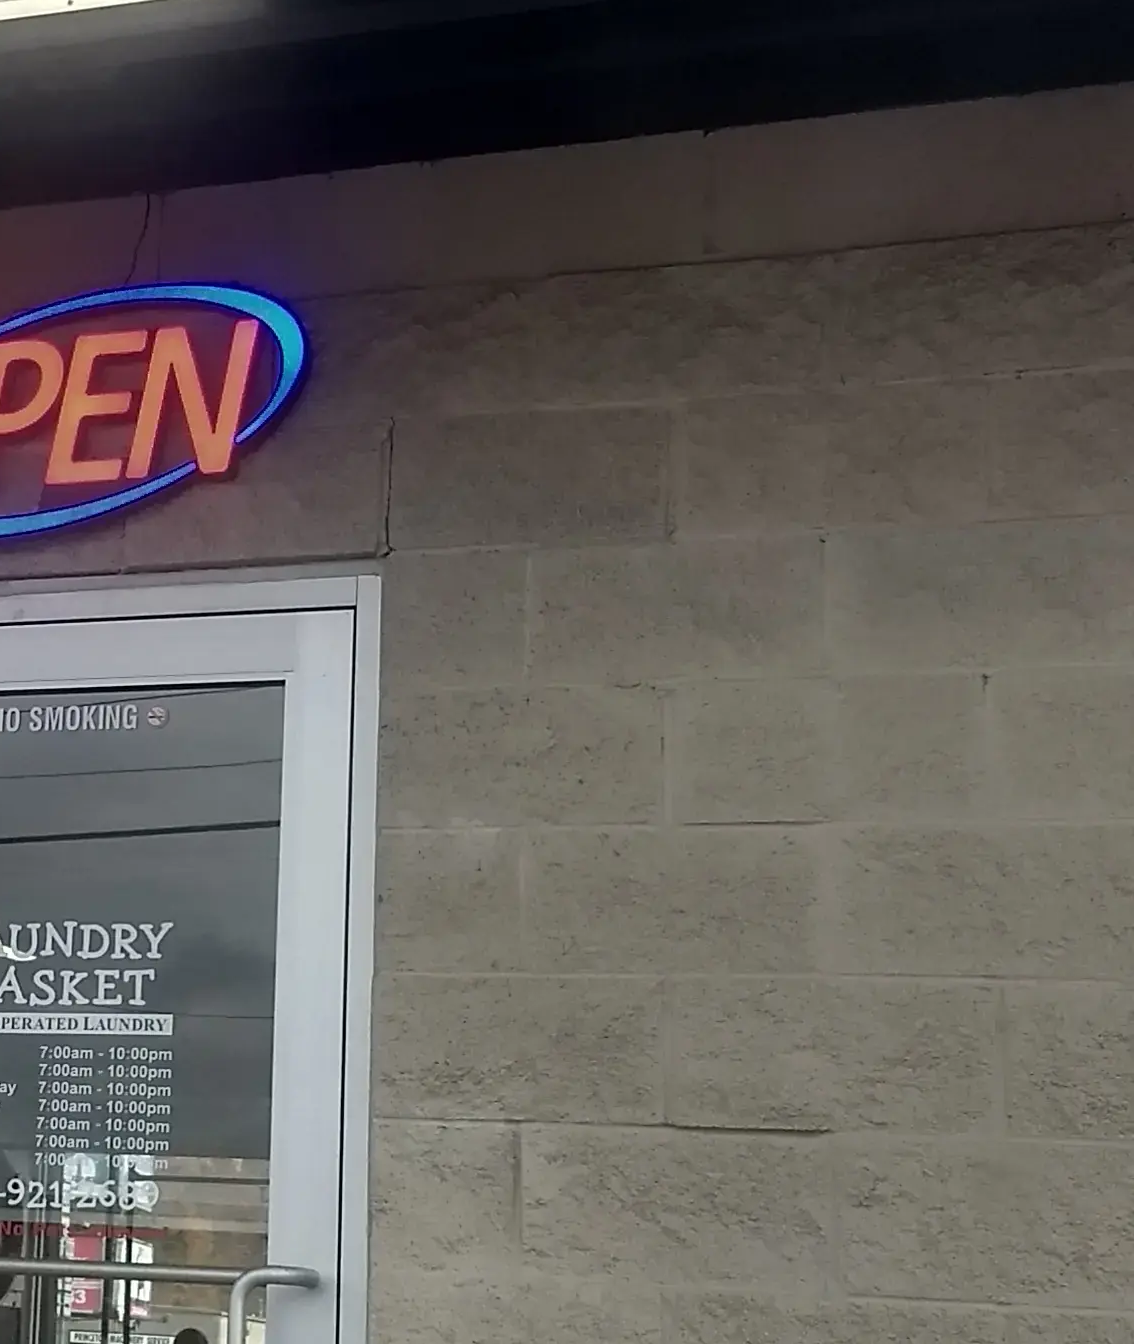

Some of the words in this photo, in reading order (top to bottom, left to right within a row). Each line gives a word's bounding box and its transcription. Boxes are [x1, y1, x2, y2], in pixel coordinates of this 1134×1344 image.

[29, 704, 138, 732] SMOKING
[83, 1016, 168, 1033] LAUNDRY
[39, 1046, 94, 1059] 7:00am
[108, 1047, 173, 1063] 10:00pm
[38, 1063, 93, 1077] 7:00am
[107, 1065, 172, 1080] 10:00pm
[37, 1082, 93, 1095] 7:00am
[106, 1083, 172, 1099] 10:00pm
[37, 1099, 93, 1113] 7:00am
[106, 1101, 171, 1116] 10:00pm
[36, 1117, 91, 1131] 7:00am
[105, 1119, 170, 1134] 10:00pm
[35, 1135, 89, 1149] 7:00am
[104, 1136, 169, 1152] 10:00pm
